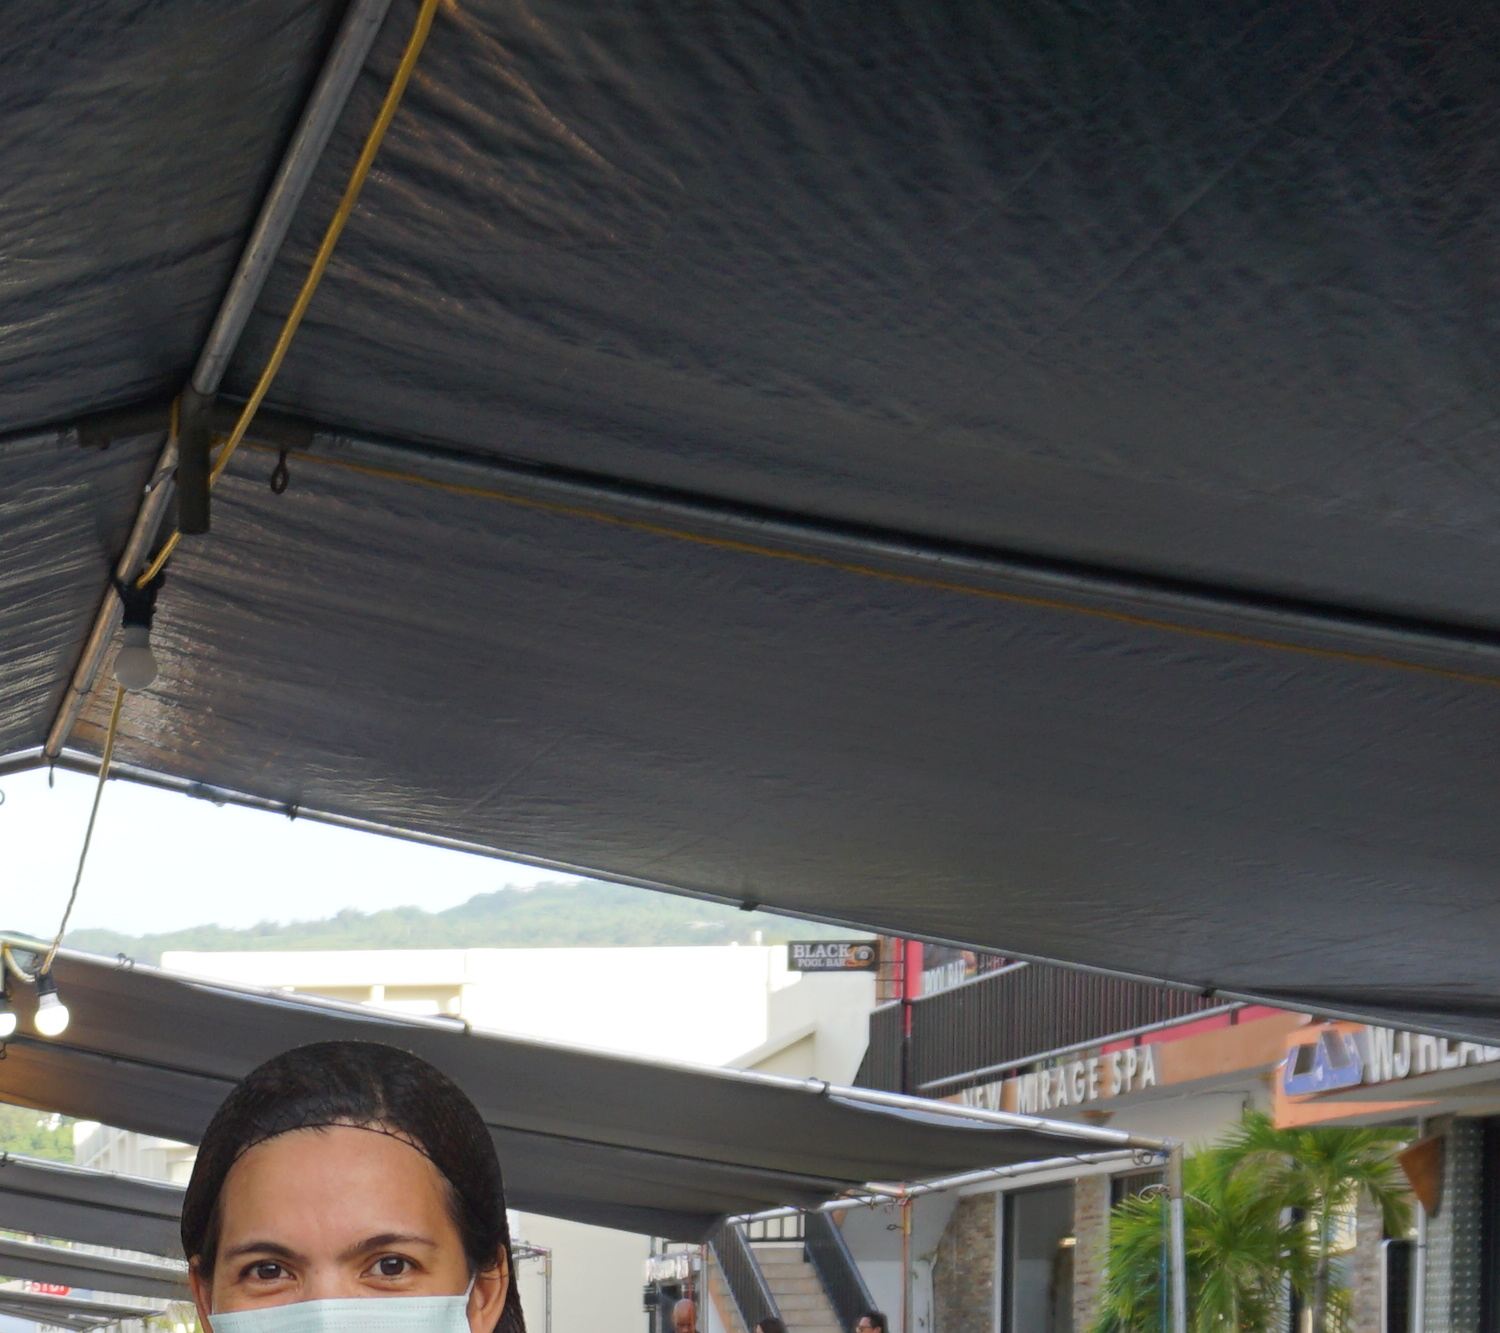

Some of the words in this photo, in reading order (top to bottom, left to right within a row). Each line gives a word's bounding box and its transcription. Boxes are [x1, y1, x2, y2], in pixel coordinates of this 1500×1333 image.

[793, 944, 850, 959] BLACK
[798, 958, 825, 967] POOL
[827, 958, 847, 967] BAR
[1016, 1057, 1099, 1114] MIRAGE
[1111, 1043, 1156, 1095] SPA
